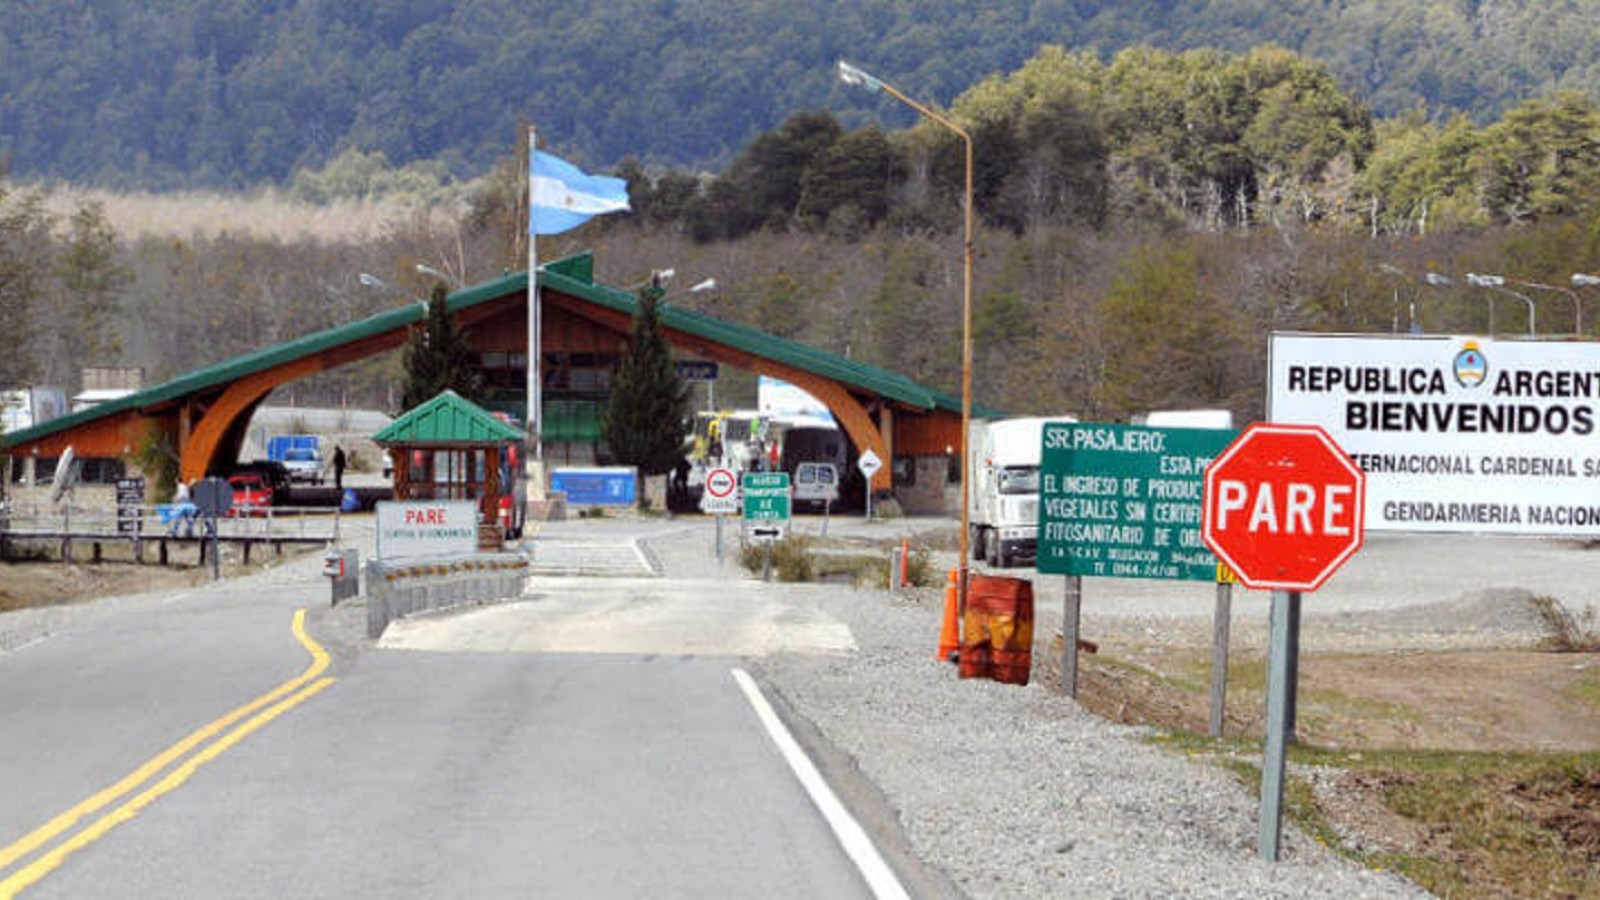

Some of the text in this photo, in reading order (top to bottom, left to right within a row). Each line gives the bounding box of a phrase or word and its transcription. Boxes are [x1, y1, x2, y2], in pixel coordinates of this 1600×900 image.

[1288, 366, 1446, 394] REPUBLICA
[1346, 402, 1594, 435] BIENVENIDOS
[1160, 456, 1192, 475] ESTA
[1349, 454, 1475, 475] TERNACIONAL
[1480, 456, 1577, 477] CARDENAL
[1045, 475, 1202, 500] EL INGRESO DE PRODUC
[405, 508, 447, 524] PARE
[1045, 499, 1118, 521] VEGETALES
[1126, 502, 1146, 522] SIN
[1217, 480, 1352, 535] PARE
[1383, 501, 1600, 527] GENDARMERIA NACION
[1045, 523, 1144, 545] FITOSANITARIO
[1154, 528, 1172, 546] DE
